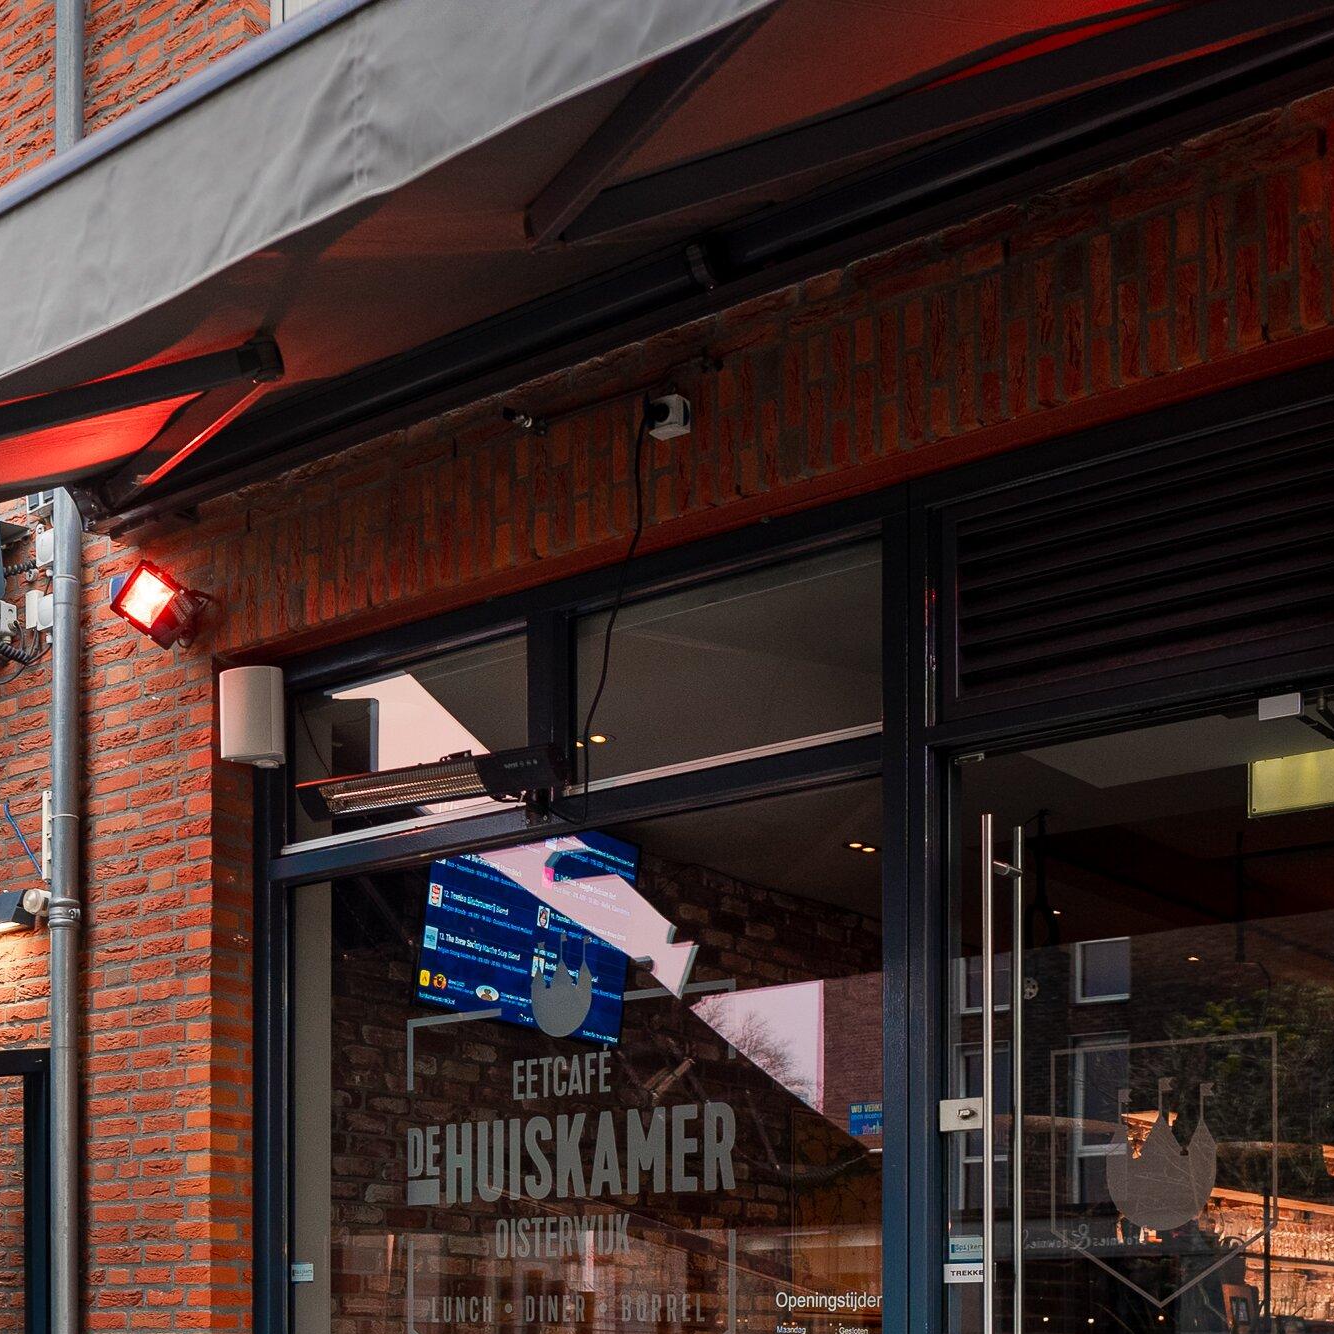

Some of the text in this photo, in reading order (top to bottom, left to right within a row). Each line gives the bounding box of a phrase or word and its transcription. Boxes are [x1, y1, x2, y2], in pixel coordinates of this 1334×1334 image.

[512, 1043, 612, 1101] EETCAFÉ
[407, 1102, 736, 1205] DE HUISKAMER
[495, 1213, 631, 1260] OISTERWIJK
[430, 1293, 706, 1324] LUNCH DINER BORREL
[776, 1326, 807, 1334] Maandag
[838, 1326, 869, 1334] Gesloten
